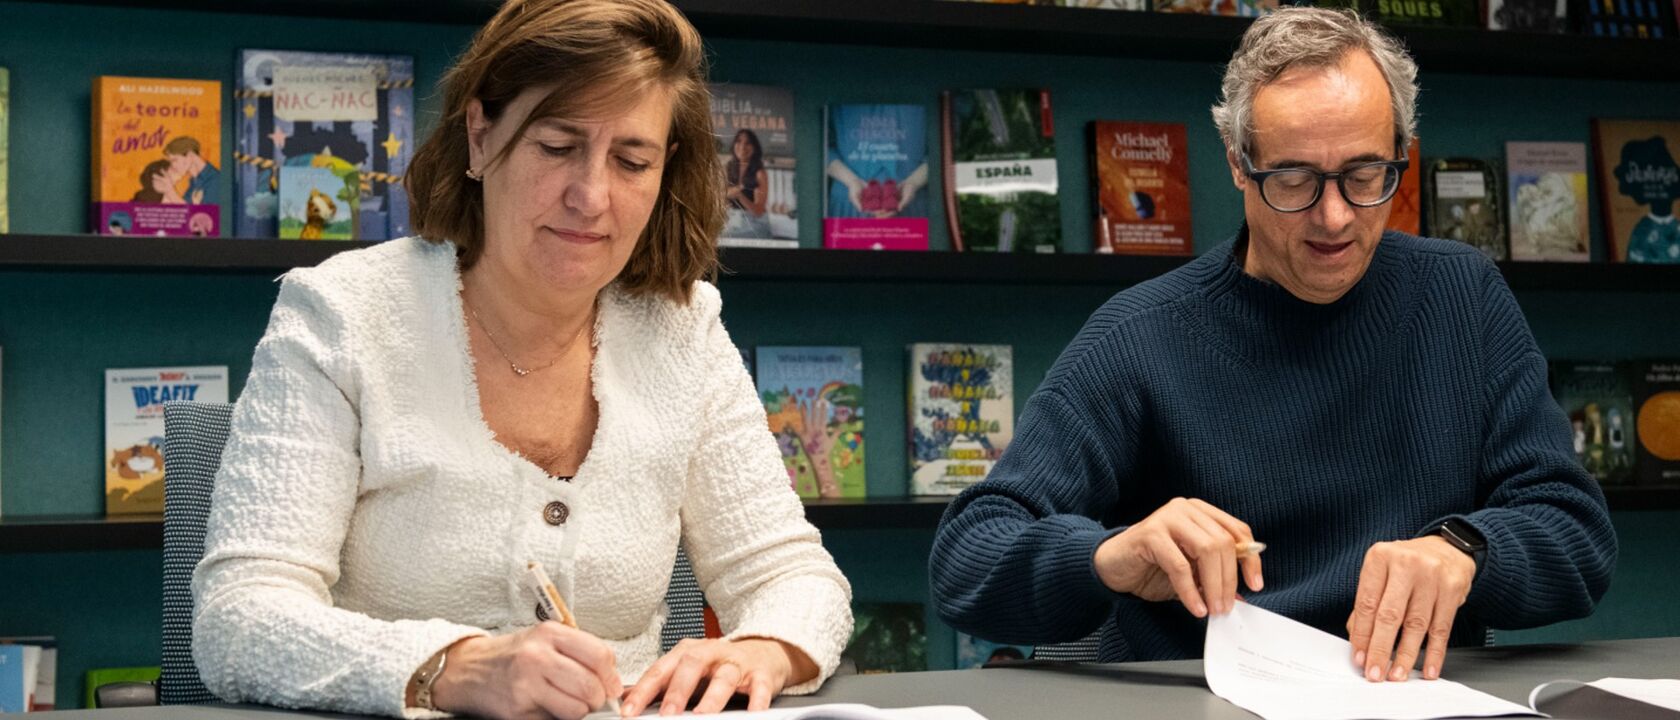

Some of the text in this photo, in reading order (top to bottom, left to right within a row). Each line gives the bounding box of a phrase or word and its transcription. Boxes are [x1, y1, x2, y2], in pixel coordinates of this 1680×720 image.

[138, 85, 204, 95] HAZELWOOD
[275, 86, 375, 111] ÑAC-ÑAC
[136, 102, 199, 118] teoría
[731, 114, 787, 131] VEGANA
[112, 125, 169, 154] amor
[1115, 132, 1168, 149] Michael
[1110, 146, 1173, 165] Connelly
[975, 162, 1033, 179] ESPAÑA
